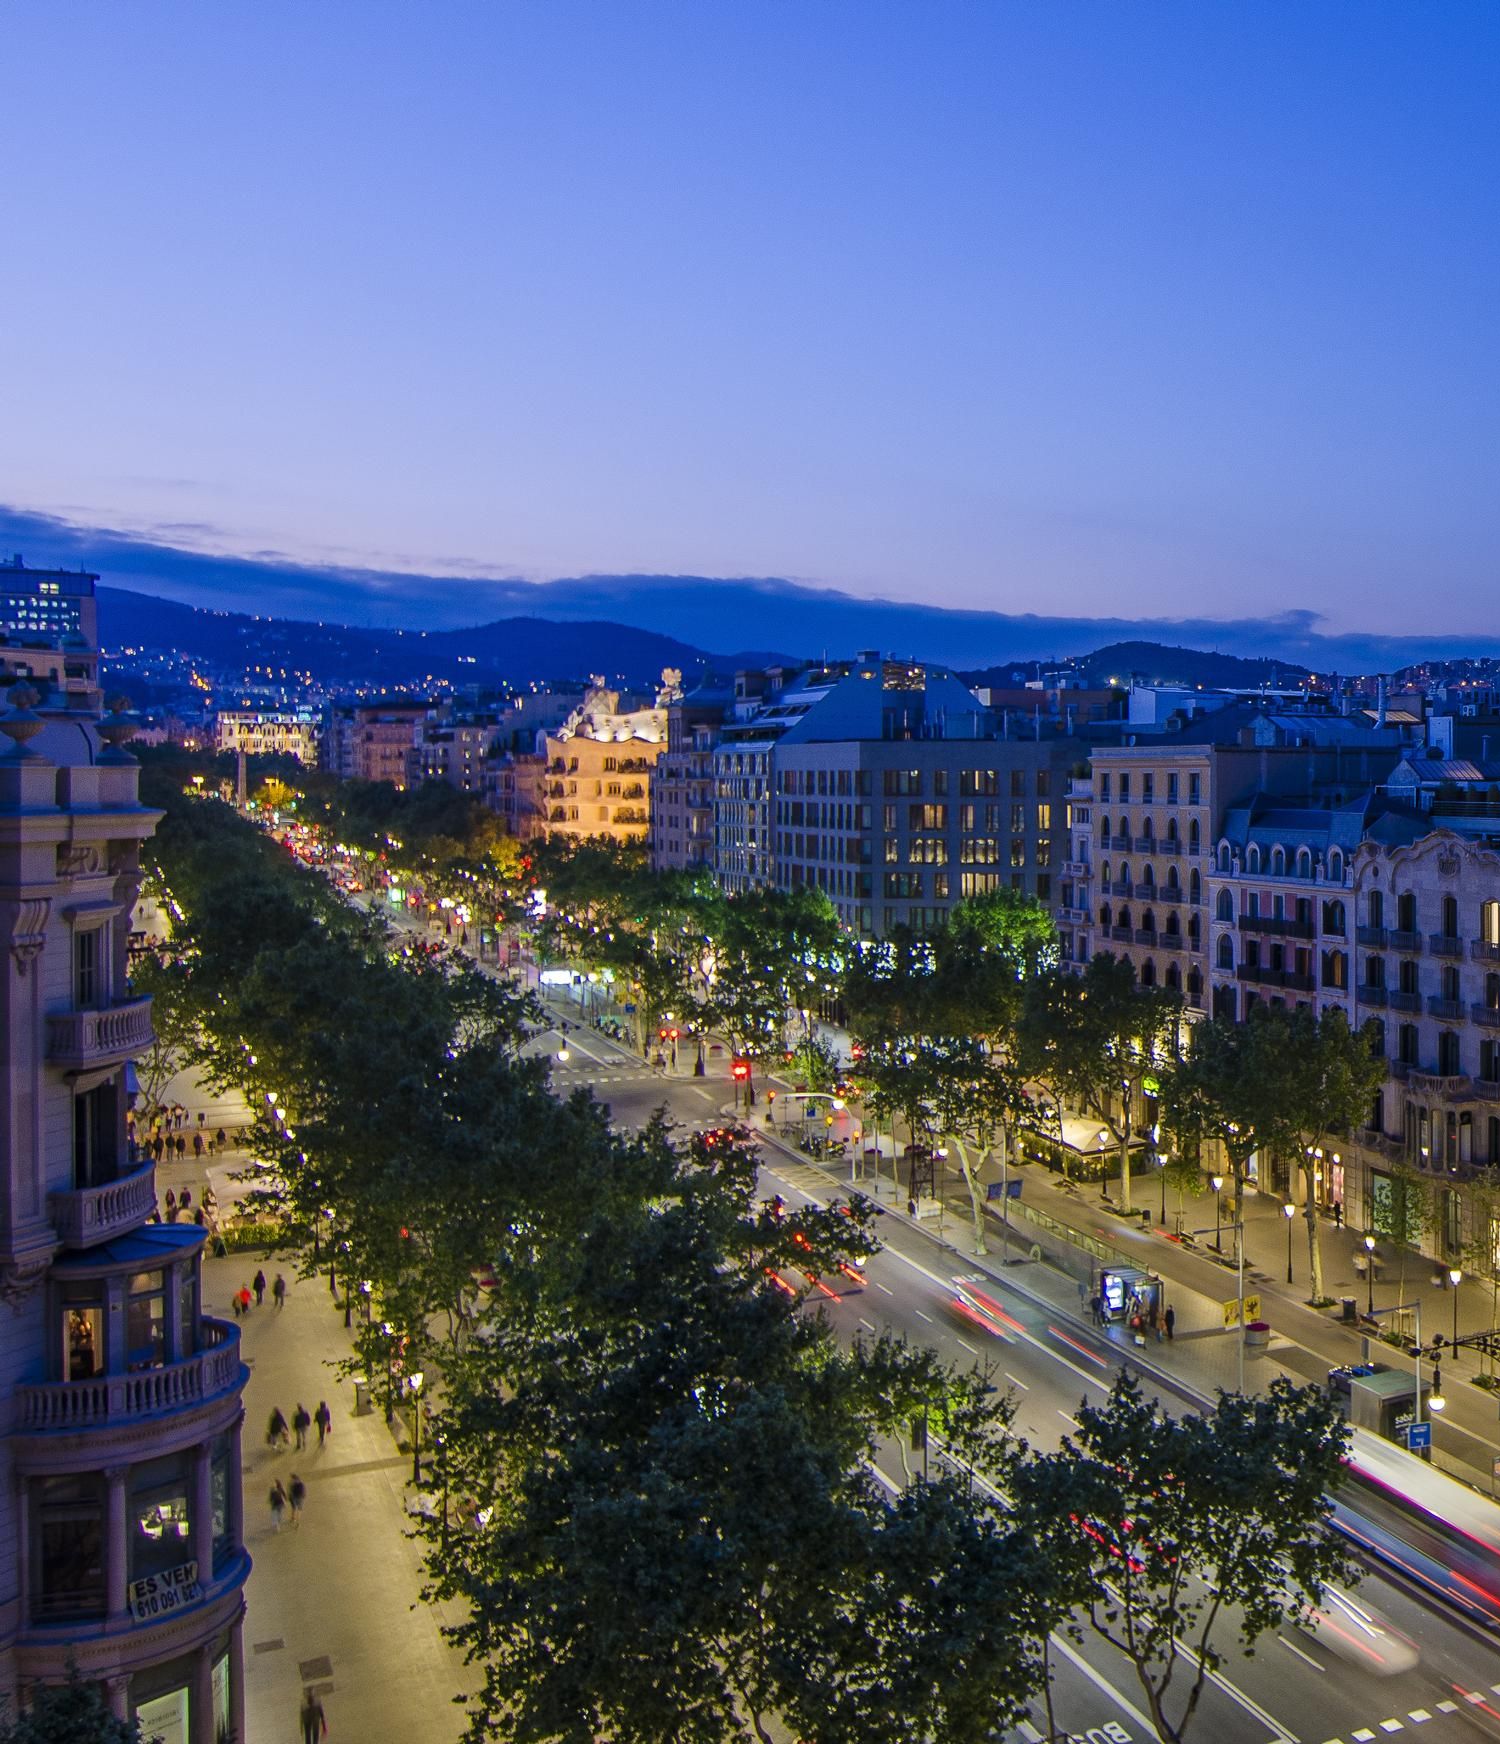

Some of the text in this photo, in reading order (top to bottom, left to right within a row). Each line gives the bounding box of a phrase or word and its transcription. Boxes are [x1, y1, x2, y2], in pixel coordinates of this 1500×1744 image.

[135, 1577, 158, 1599] ES
[137, 1596, 159, 1618] 610
[160, 1589, 180, 1610] 091
